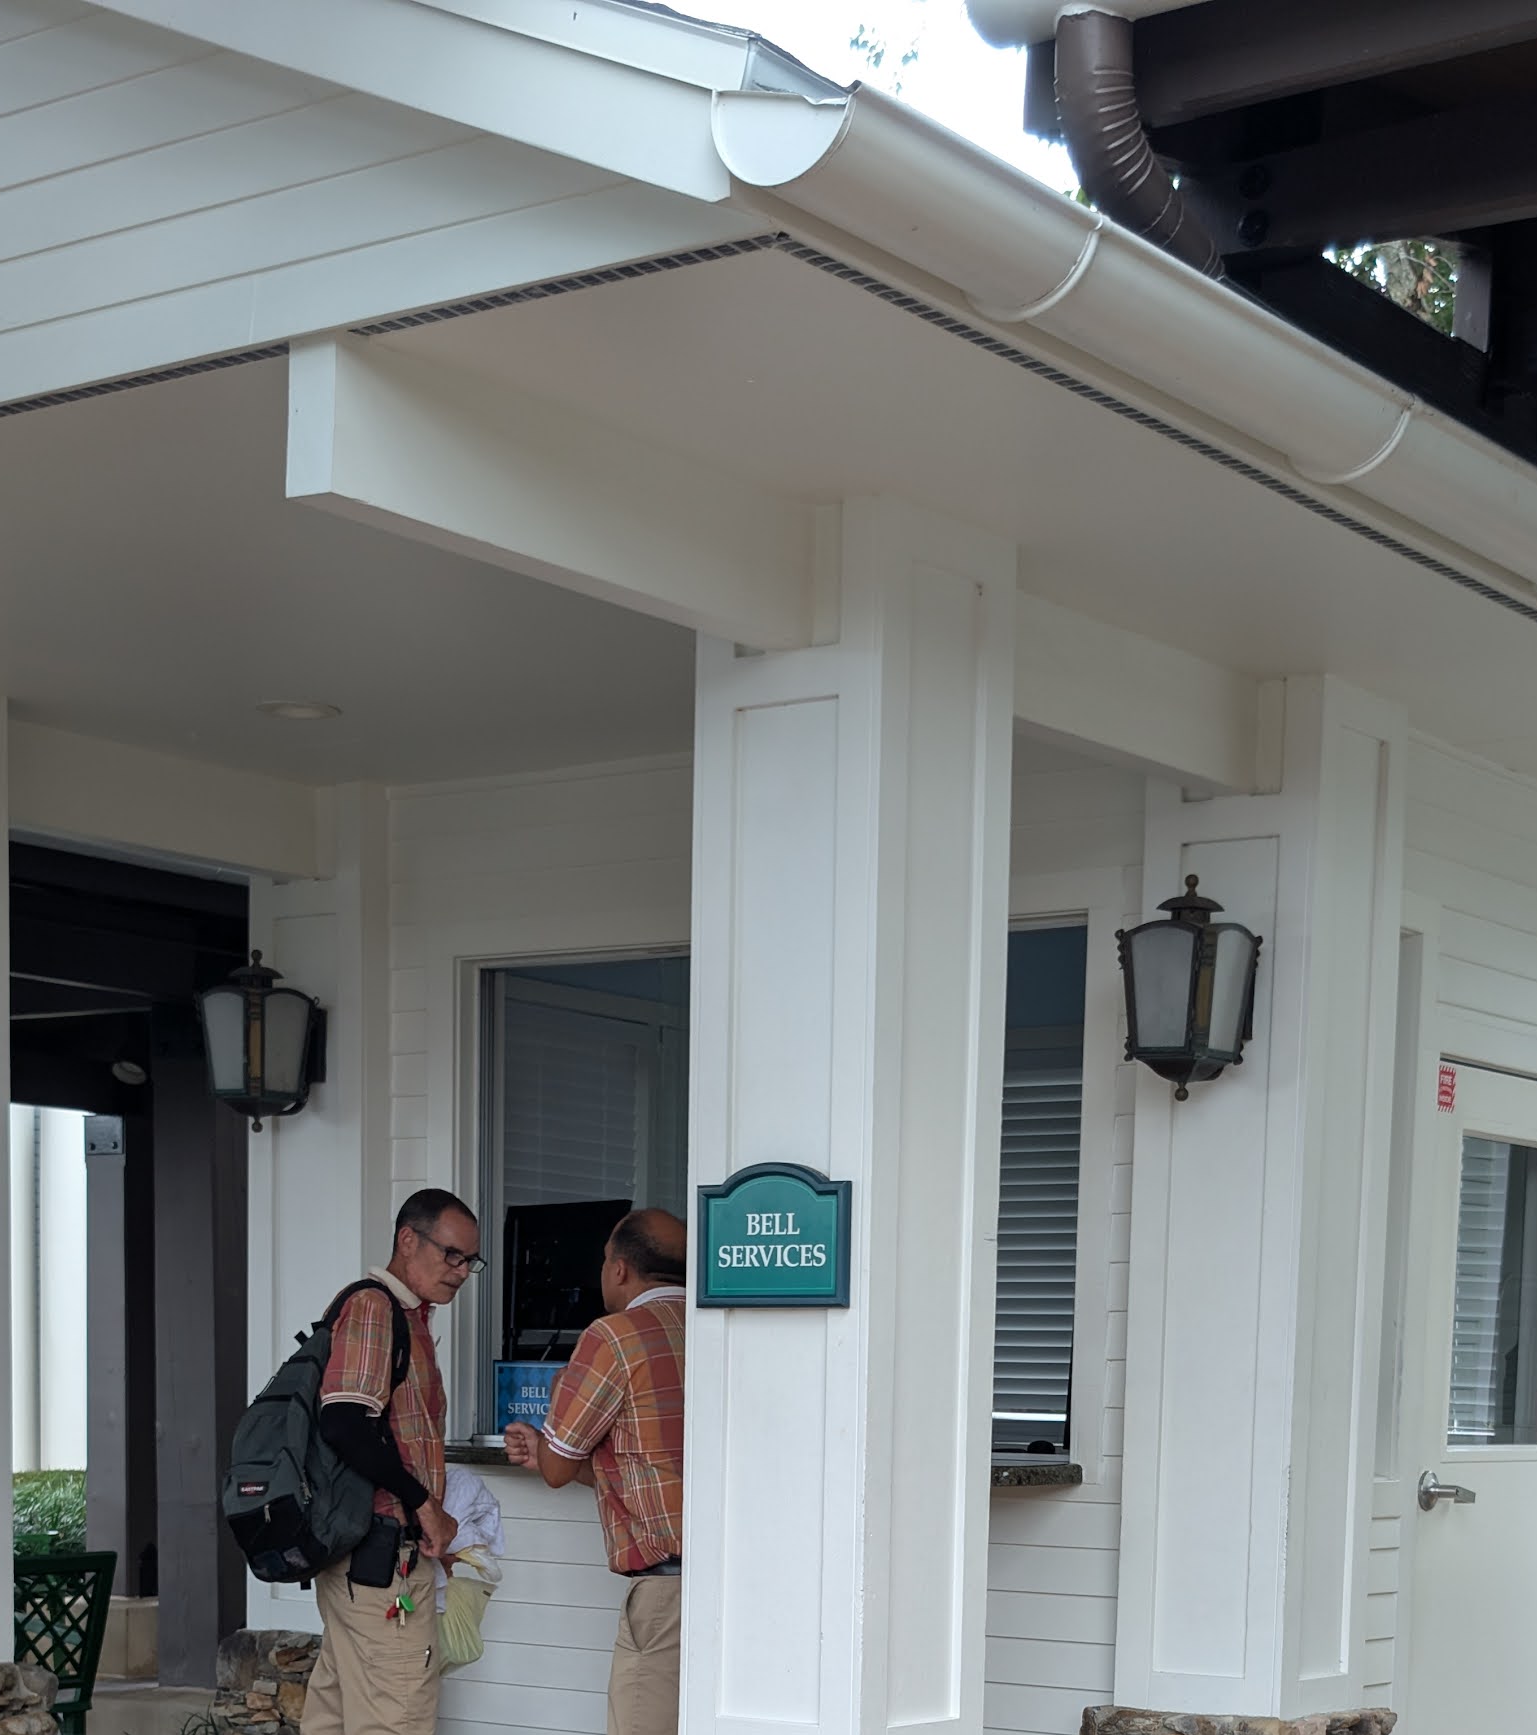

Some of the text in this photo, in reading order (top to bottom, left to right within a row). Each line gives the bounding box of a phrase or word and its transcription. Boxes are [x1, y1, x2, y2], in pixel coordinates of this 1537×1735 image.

[746, 1212, 801, 1236] BELL
[718, 1243, 827, 1268] SERVICES
[521, 1386, 549, 1399] BELL
[507, 1402, 551, 1416] SERVIC
